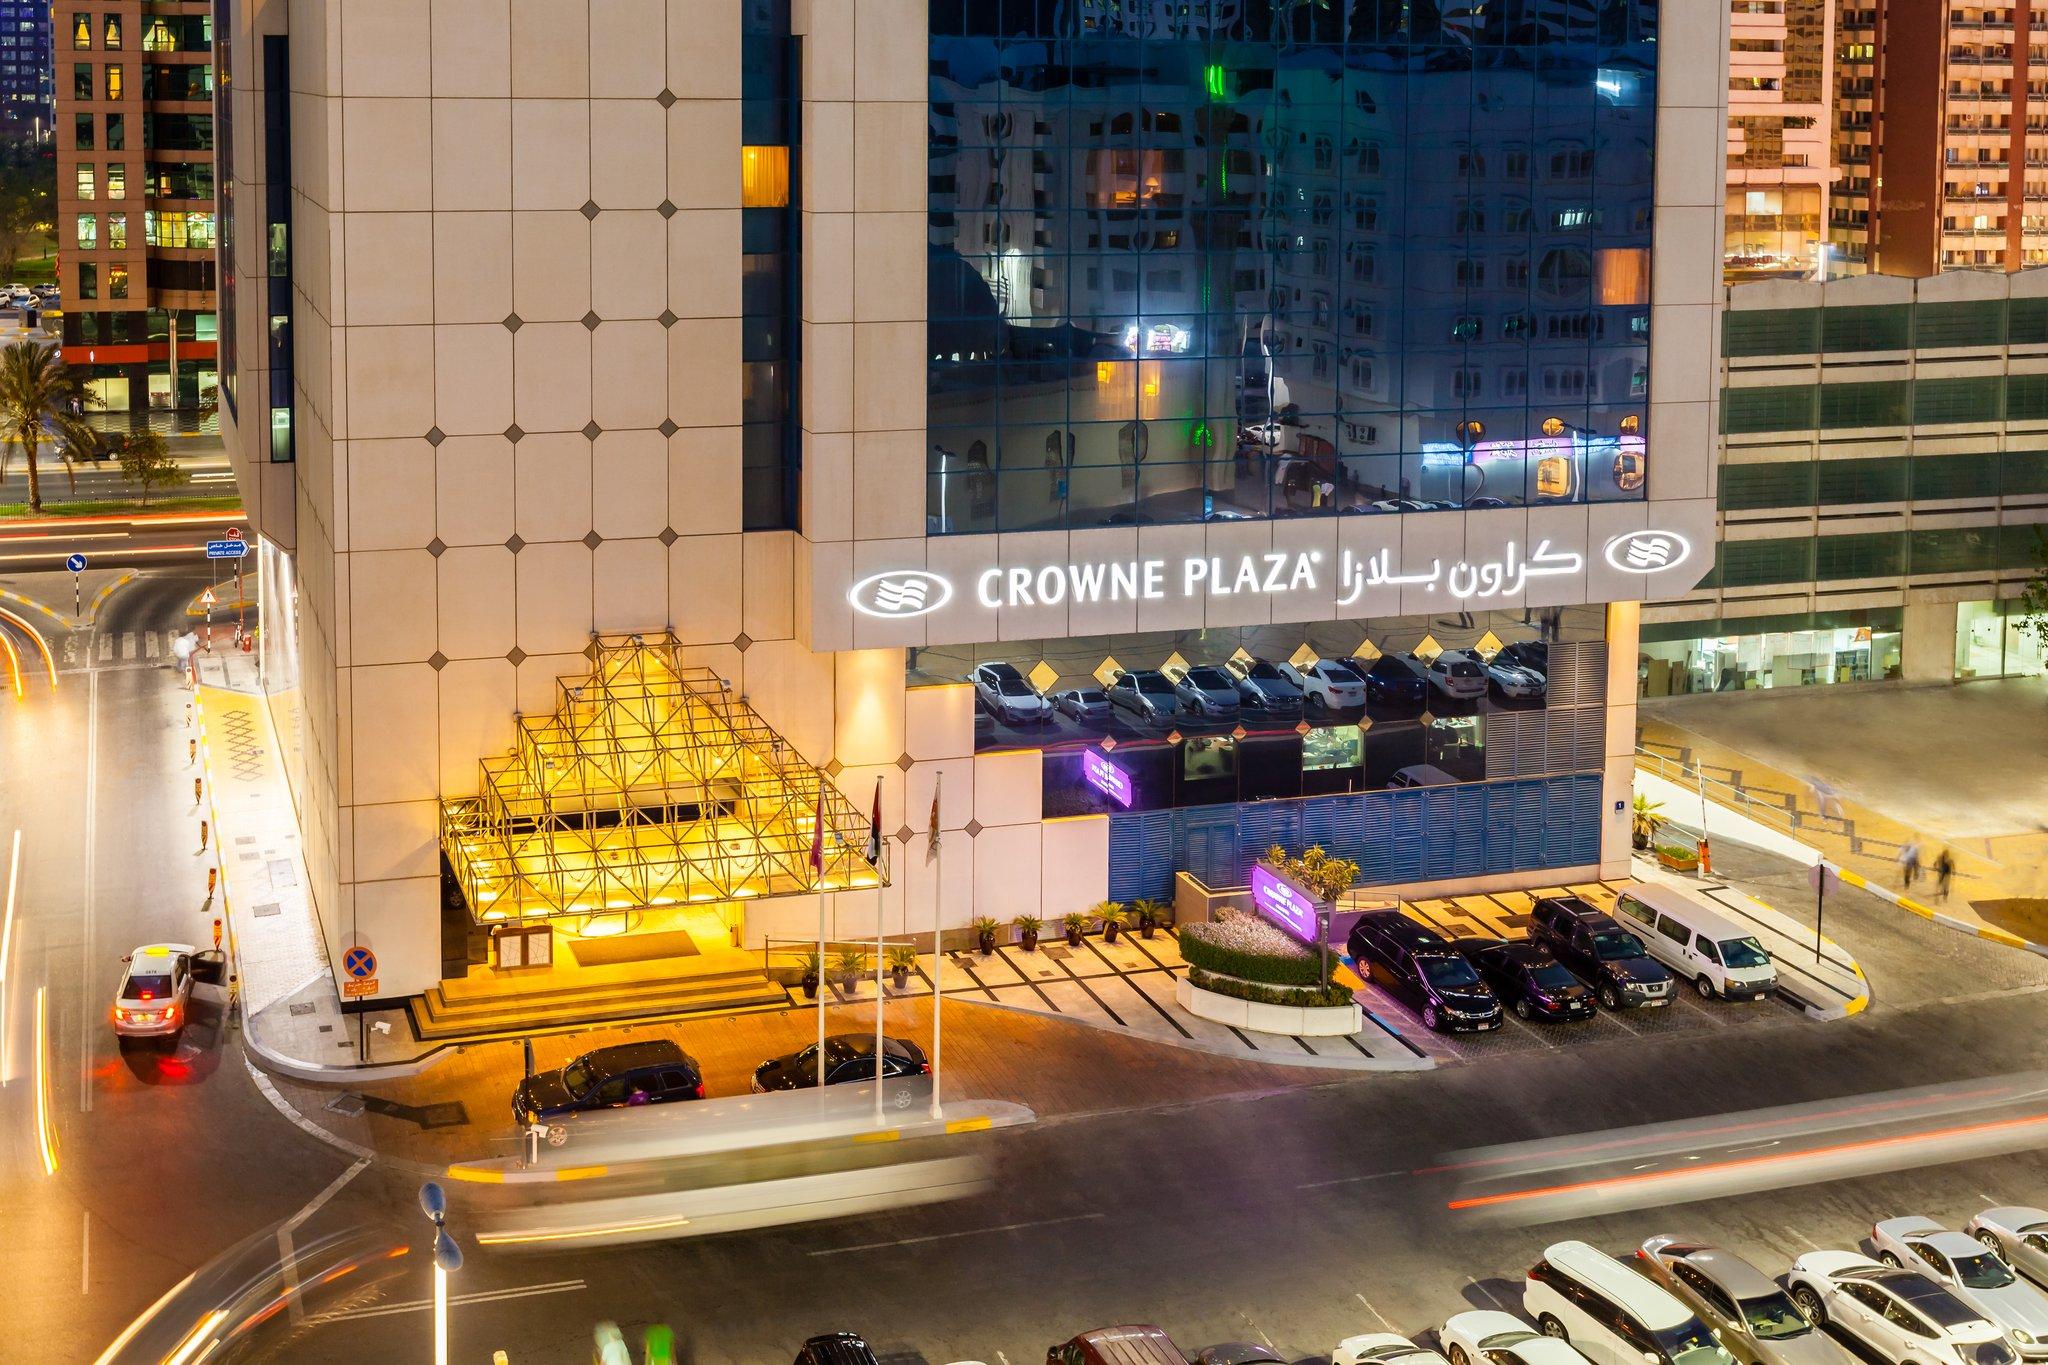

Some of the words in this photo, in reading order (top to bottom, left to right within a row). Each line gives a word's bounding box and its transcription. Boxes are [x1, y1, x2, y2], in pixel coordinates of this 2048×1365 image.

[978, 560, 1164, 608] CROWNE
[1337, 549, 1440, 606] بلازا
[1449, 540, 1582, 598] كراون
